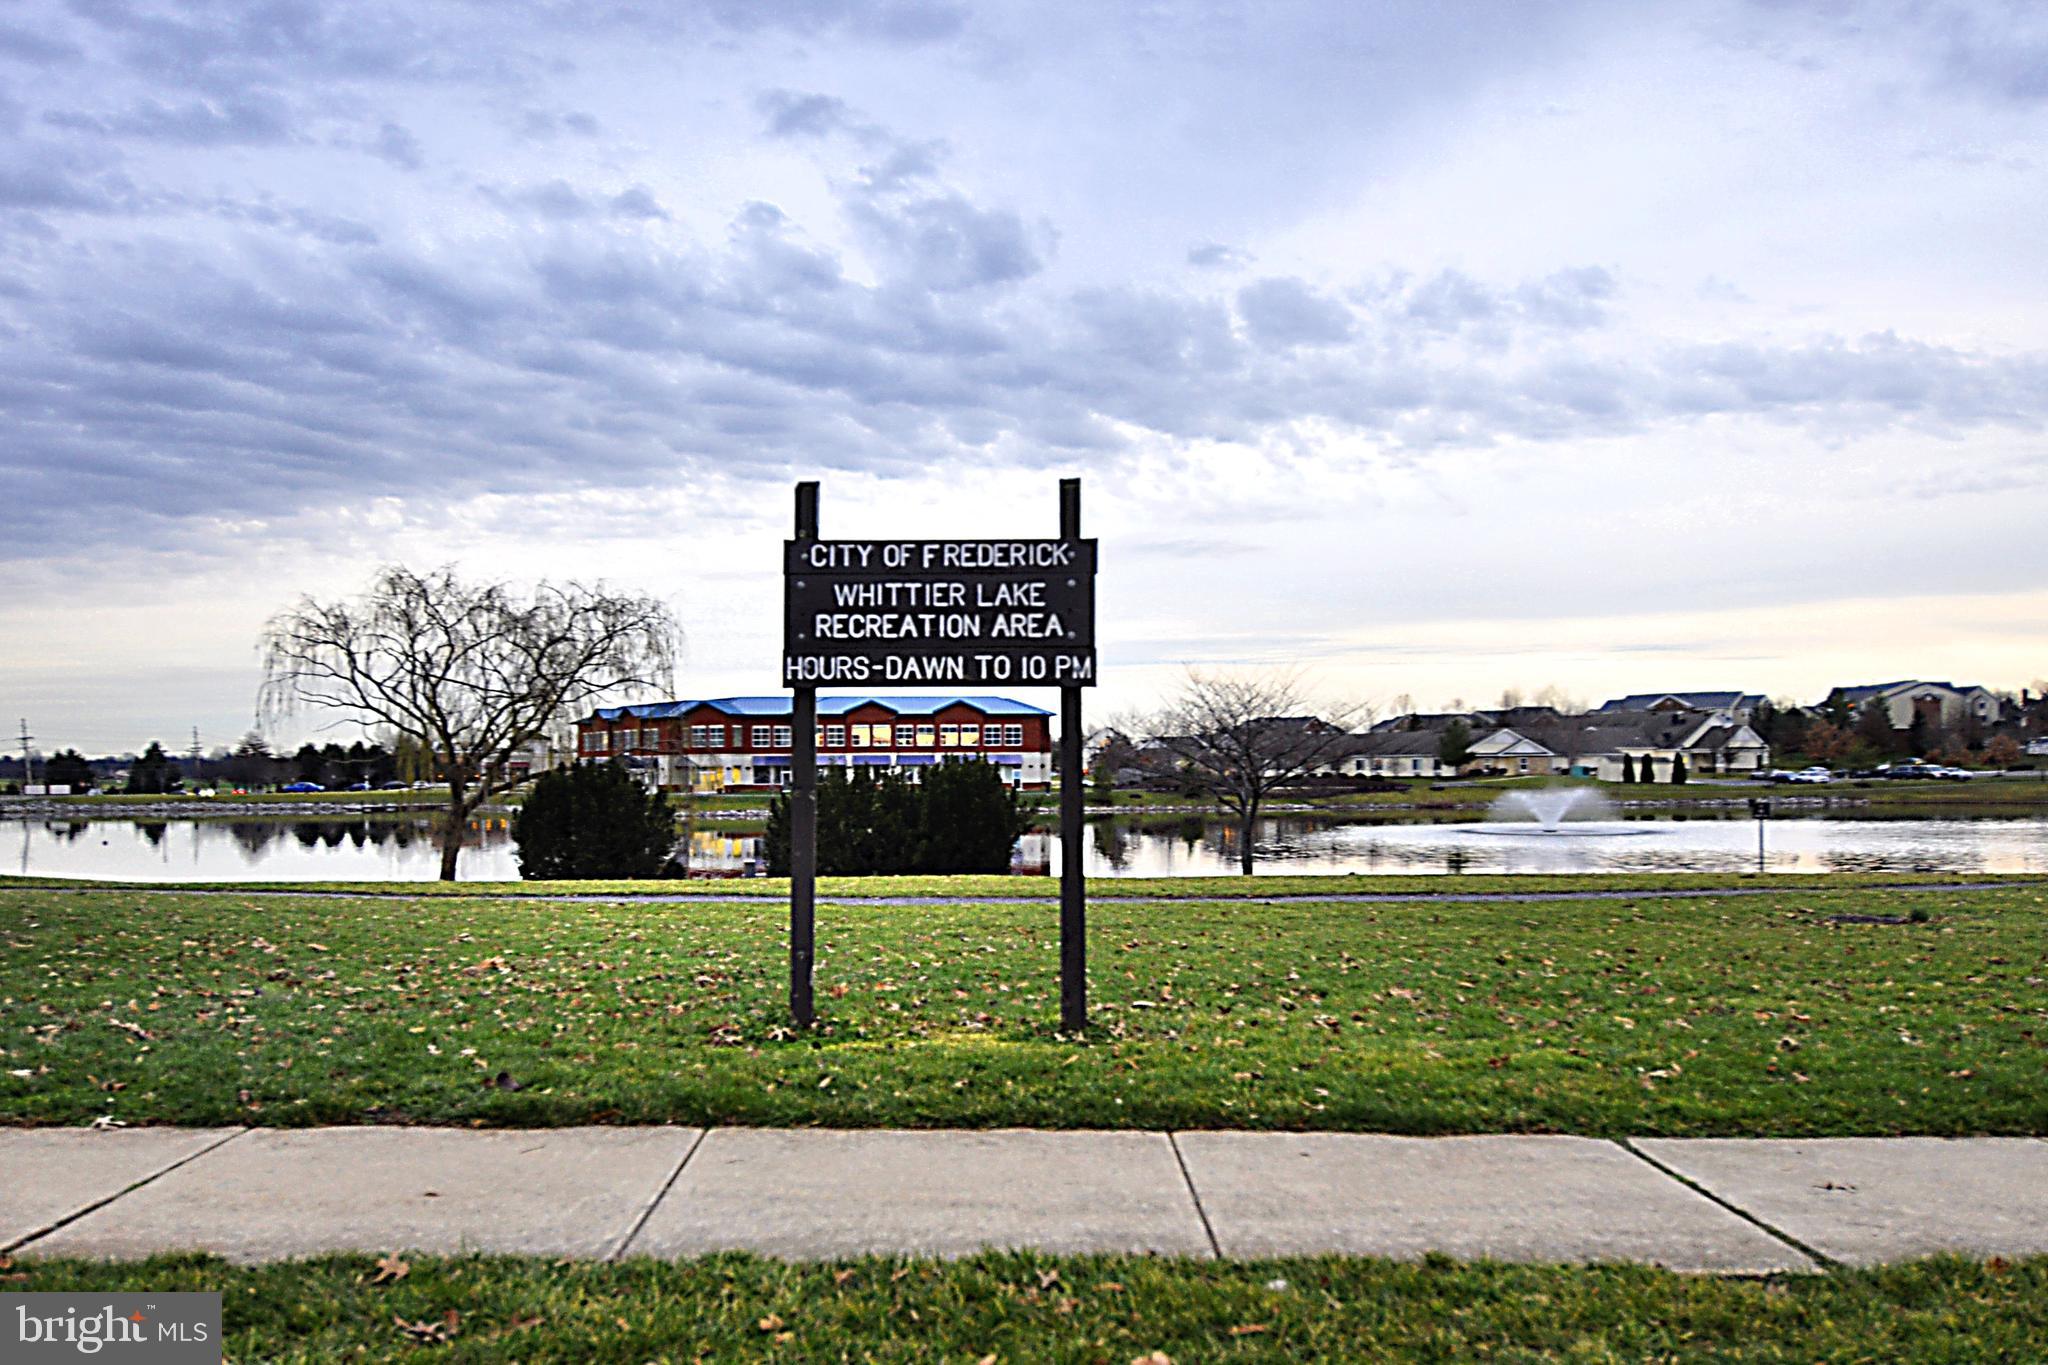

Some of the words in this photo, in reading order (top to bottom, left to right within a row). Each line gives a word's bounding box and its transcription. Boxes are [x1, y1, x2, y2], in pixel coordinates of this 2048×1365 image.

[809, 544, 874, 568] CITY
[883, 544, 917, 568] OF
[923, 543, 1070, 568] FREDERICK
[834, 582, 967, 607] WHITTIER
[977, 582, 1046, 607] LAKE
[815, 613, 980, 639] RECREATION
[991, 613, 1064, 638] AREA
[786, 655, 964, 681] HOURS-DAWN
[975, 655, 1011, 680] TO
[1021, 655, 1046, 680] 10
[1055, 655, 1093, 680] PM
